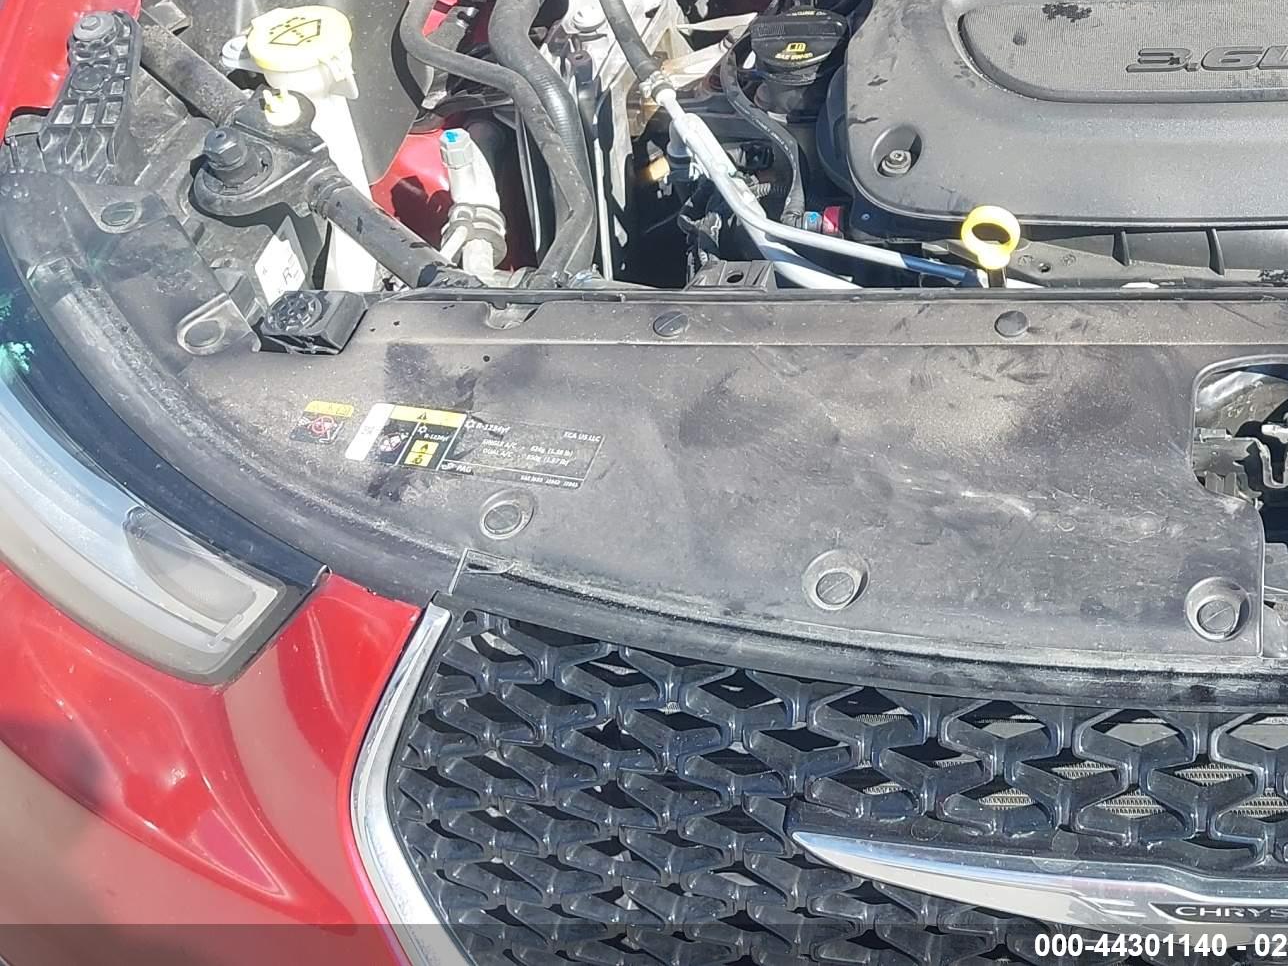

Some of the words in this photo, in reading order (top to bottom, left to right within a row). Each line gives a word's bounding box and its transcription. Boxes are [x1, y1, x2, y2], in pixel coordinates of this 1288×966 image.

[475, 422, 511, 434] R-1234yf
[563, 431, 577, 440] FCA
[578, 433, 588, 441] US
[588, 435, 601, 443] LLC
[481, 438, 504, 447] SINGLE
[504, 442, 518, 451] A/C
[456, 465, 472, 473] PAG
